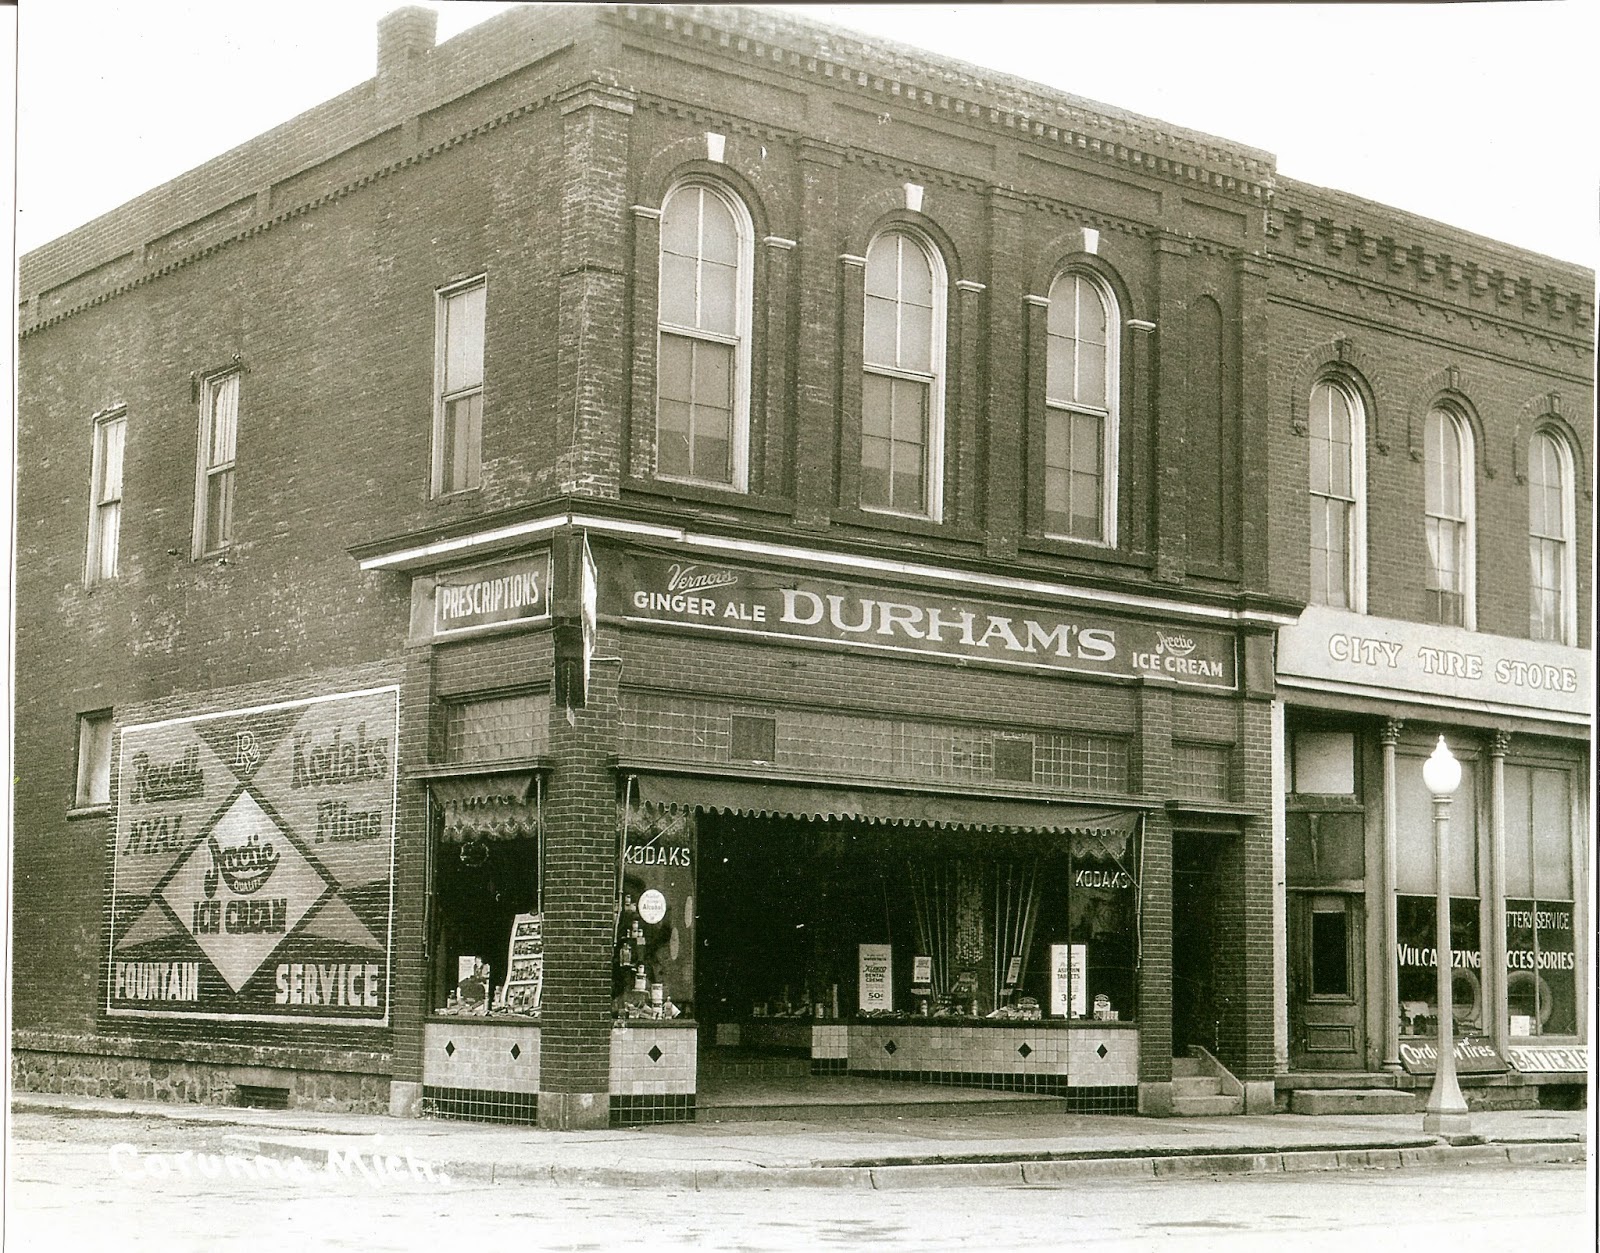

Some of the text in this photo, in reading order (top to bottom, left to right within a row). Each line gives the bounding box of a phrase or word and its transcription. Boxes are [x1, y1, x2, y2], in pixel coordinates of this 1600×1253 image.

[441, 571, 539, 620] PRESCRIPTIONS
[633, 590, 766, 623] GINGER ALE
[779, 587, 1118, 662] DURHAM'S
[1155, 630, 1197, 657] Arctic
[1132, 651, 1223, 677] ICE CREAM
[1328, 633, 1578, 693] CITY TIRE STORE
[622, 844, 691, 867] KODAKS
[1075, 869, 1129, 889] KODAKS
[192, 898, 288, 935] ICE CREAM
[1505, 911, 1533, 929] TTERY
[1397, 943, 1481, 969] VULCAIZING
[1506, 950, 1575, 969] CCESSORIES
[114, 961, 379, 1008] FOUNTAIN SERVICE
[1457, 1041, 1496, 1059] Tires
[1508, 1048, 1588, 1070] BATTERIE
